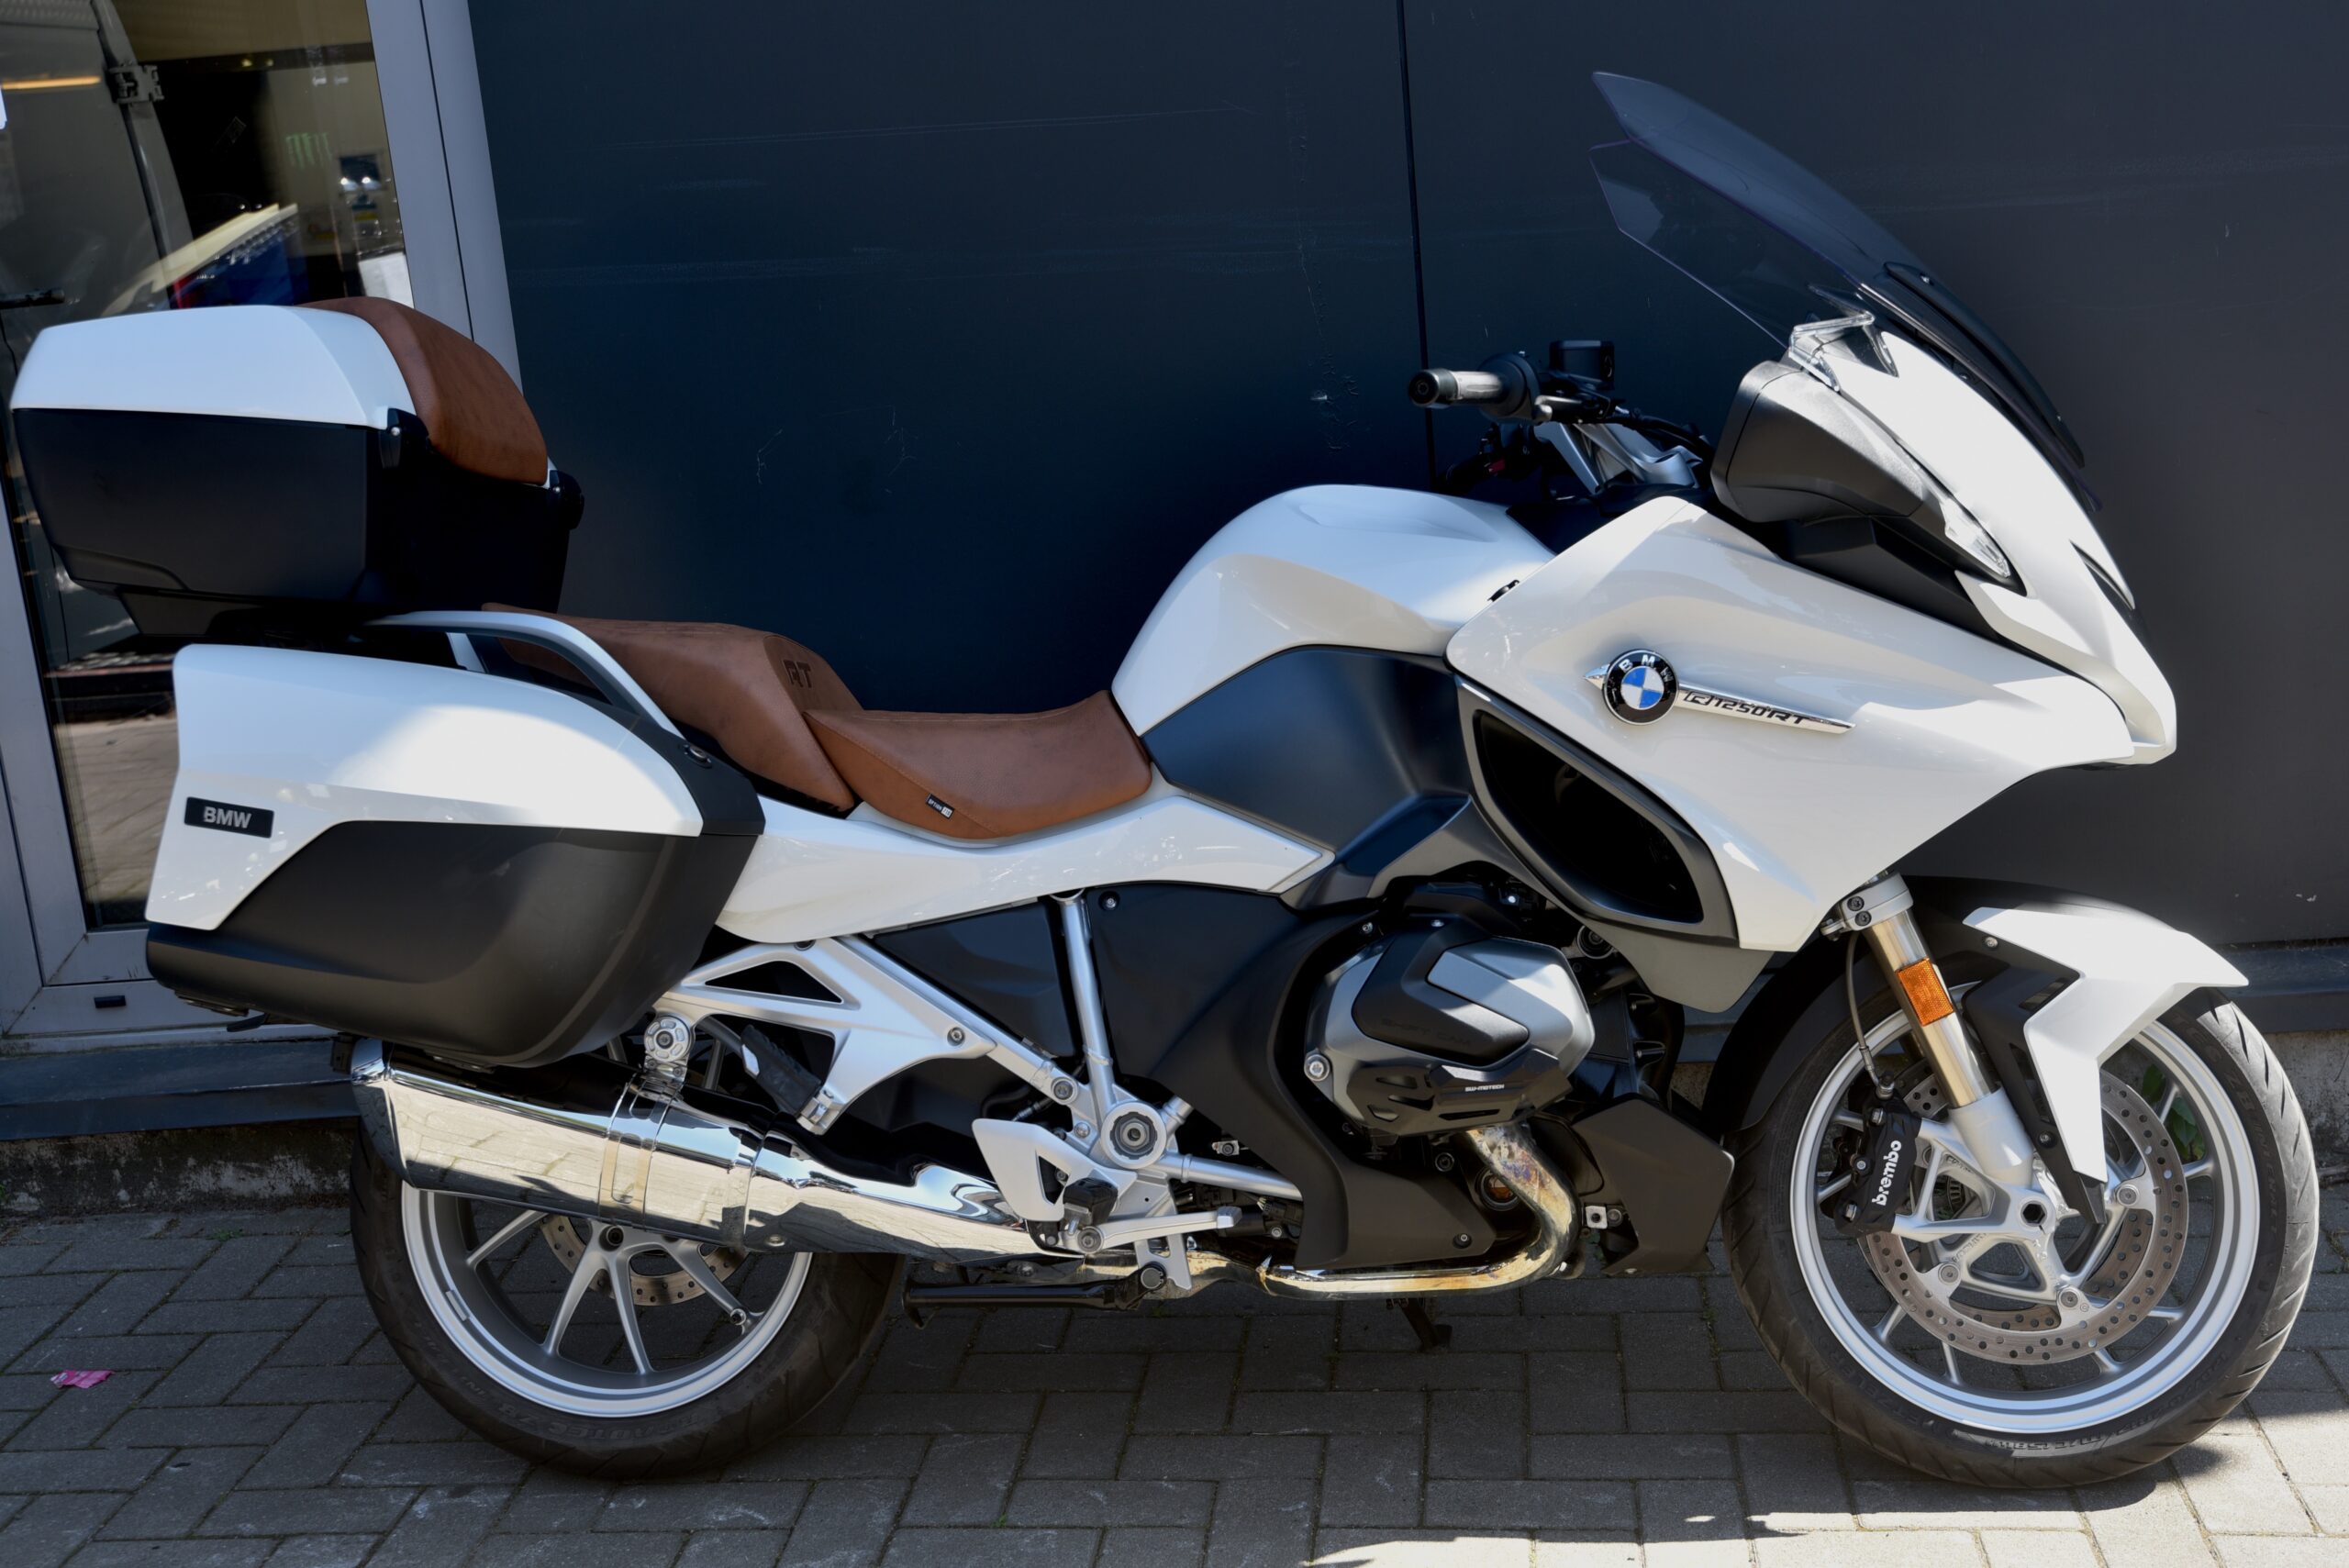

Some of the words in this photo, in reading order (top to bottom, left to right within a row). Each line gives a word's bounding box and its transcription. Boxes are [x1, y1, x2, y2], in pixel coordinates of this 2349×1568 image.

[783, 660, 812, 688] RT
[1619, 654, 1674, 682] BMW
[204, 806, 251, 828] BMW
[1872, 1140, 1902, 1206] brembo
